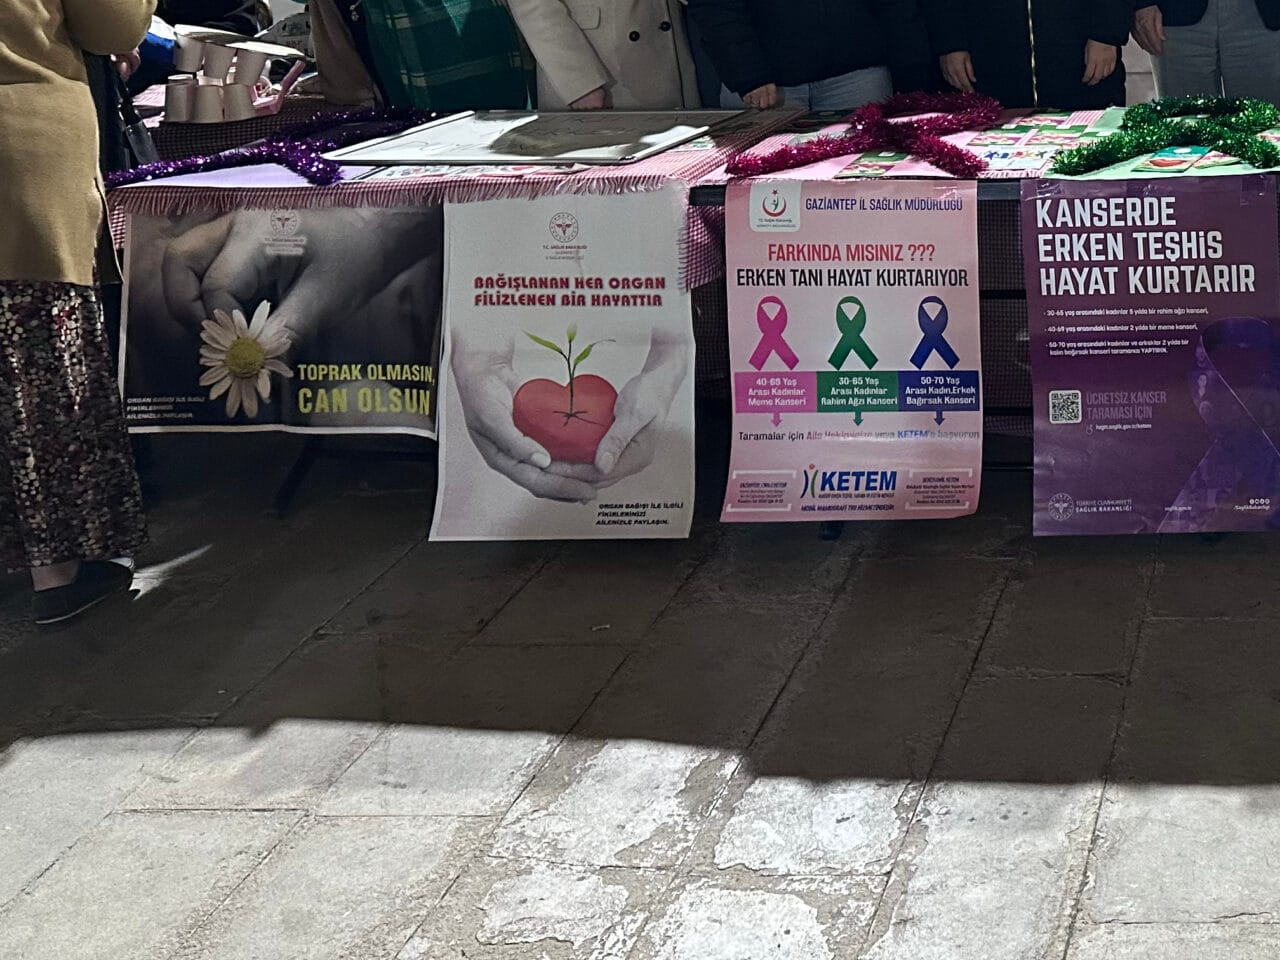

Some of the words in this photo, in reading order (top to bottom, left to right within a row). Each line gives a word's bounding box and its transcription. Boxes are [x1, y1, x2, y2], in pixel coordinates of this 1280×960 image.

[806, 196, 857, 210] GAZİANTEP
[860, 197, 867, 210] İL
[869, 196, 902, 211] SAĞLIK
[1036, 197, 1176, 228] KANSERDE
[768, 243, 842, 262] FARKINDA
[846, 243, 904, 262] MISINIZ
[908, 243, 936, 262] ???
[1038, 233, 1124, 262] ERKEN
[474, 273, 570, 291] BAĞIŞLANAN
[574, 276, 604, 290] HER
[608, 276, 666, 290] ORGAN
[737, 269, 786, 287] ERKEN
[790, 269, 824, 287] TANI
[828, 269, 873, 287] HAYAT
[876, 269, 969, 287] KURTARIYOR
[1040, 267, 1118, 296] HAYAT
[1128, 264, 1255, 294] KURTARIR
[474, 291, 556, 307] FİLİZLENEN
[561, 291, 586, 307] BİR
[591, 294, 663, 307] HAYATTIR
[297, 364, 362, 381] TOPRAK
[367, 363, 436, 386] OLMASIN,
[920, 376, 944, 385] 50-70
[945, 376, 960, 386] Yaş
[905, 386, 927, 395] Arası
[1130, 390, 1167, 404] KANSER
[299, 387, 348, 414] CAN
[357, 387, 431, 416] OLSUN
[739, 431, 786, 441] Taramalar
[788, 431, 804, 442] için
[820, 470, 898, 492] KETEM
